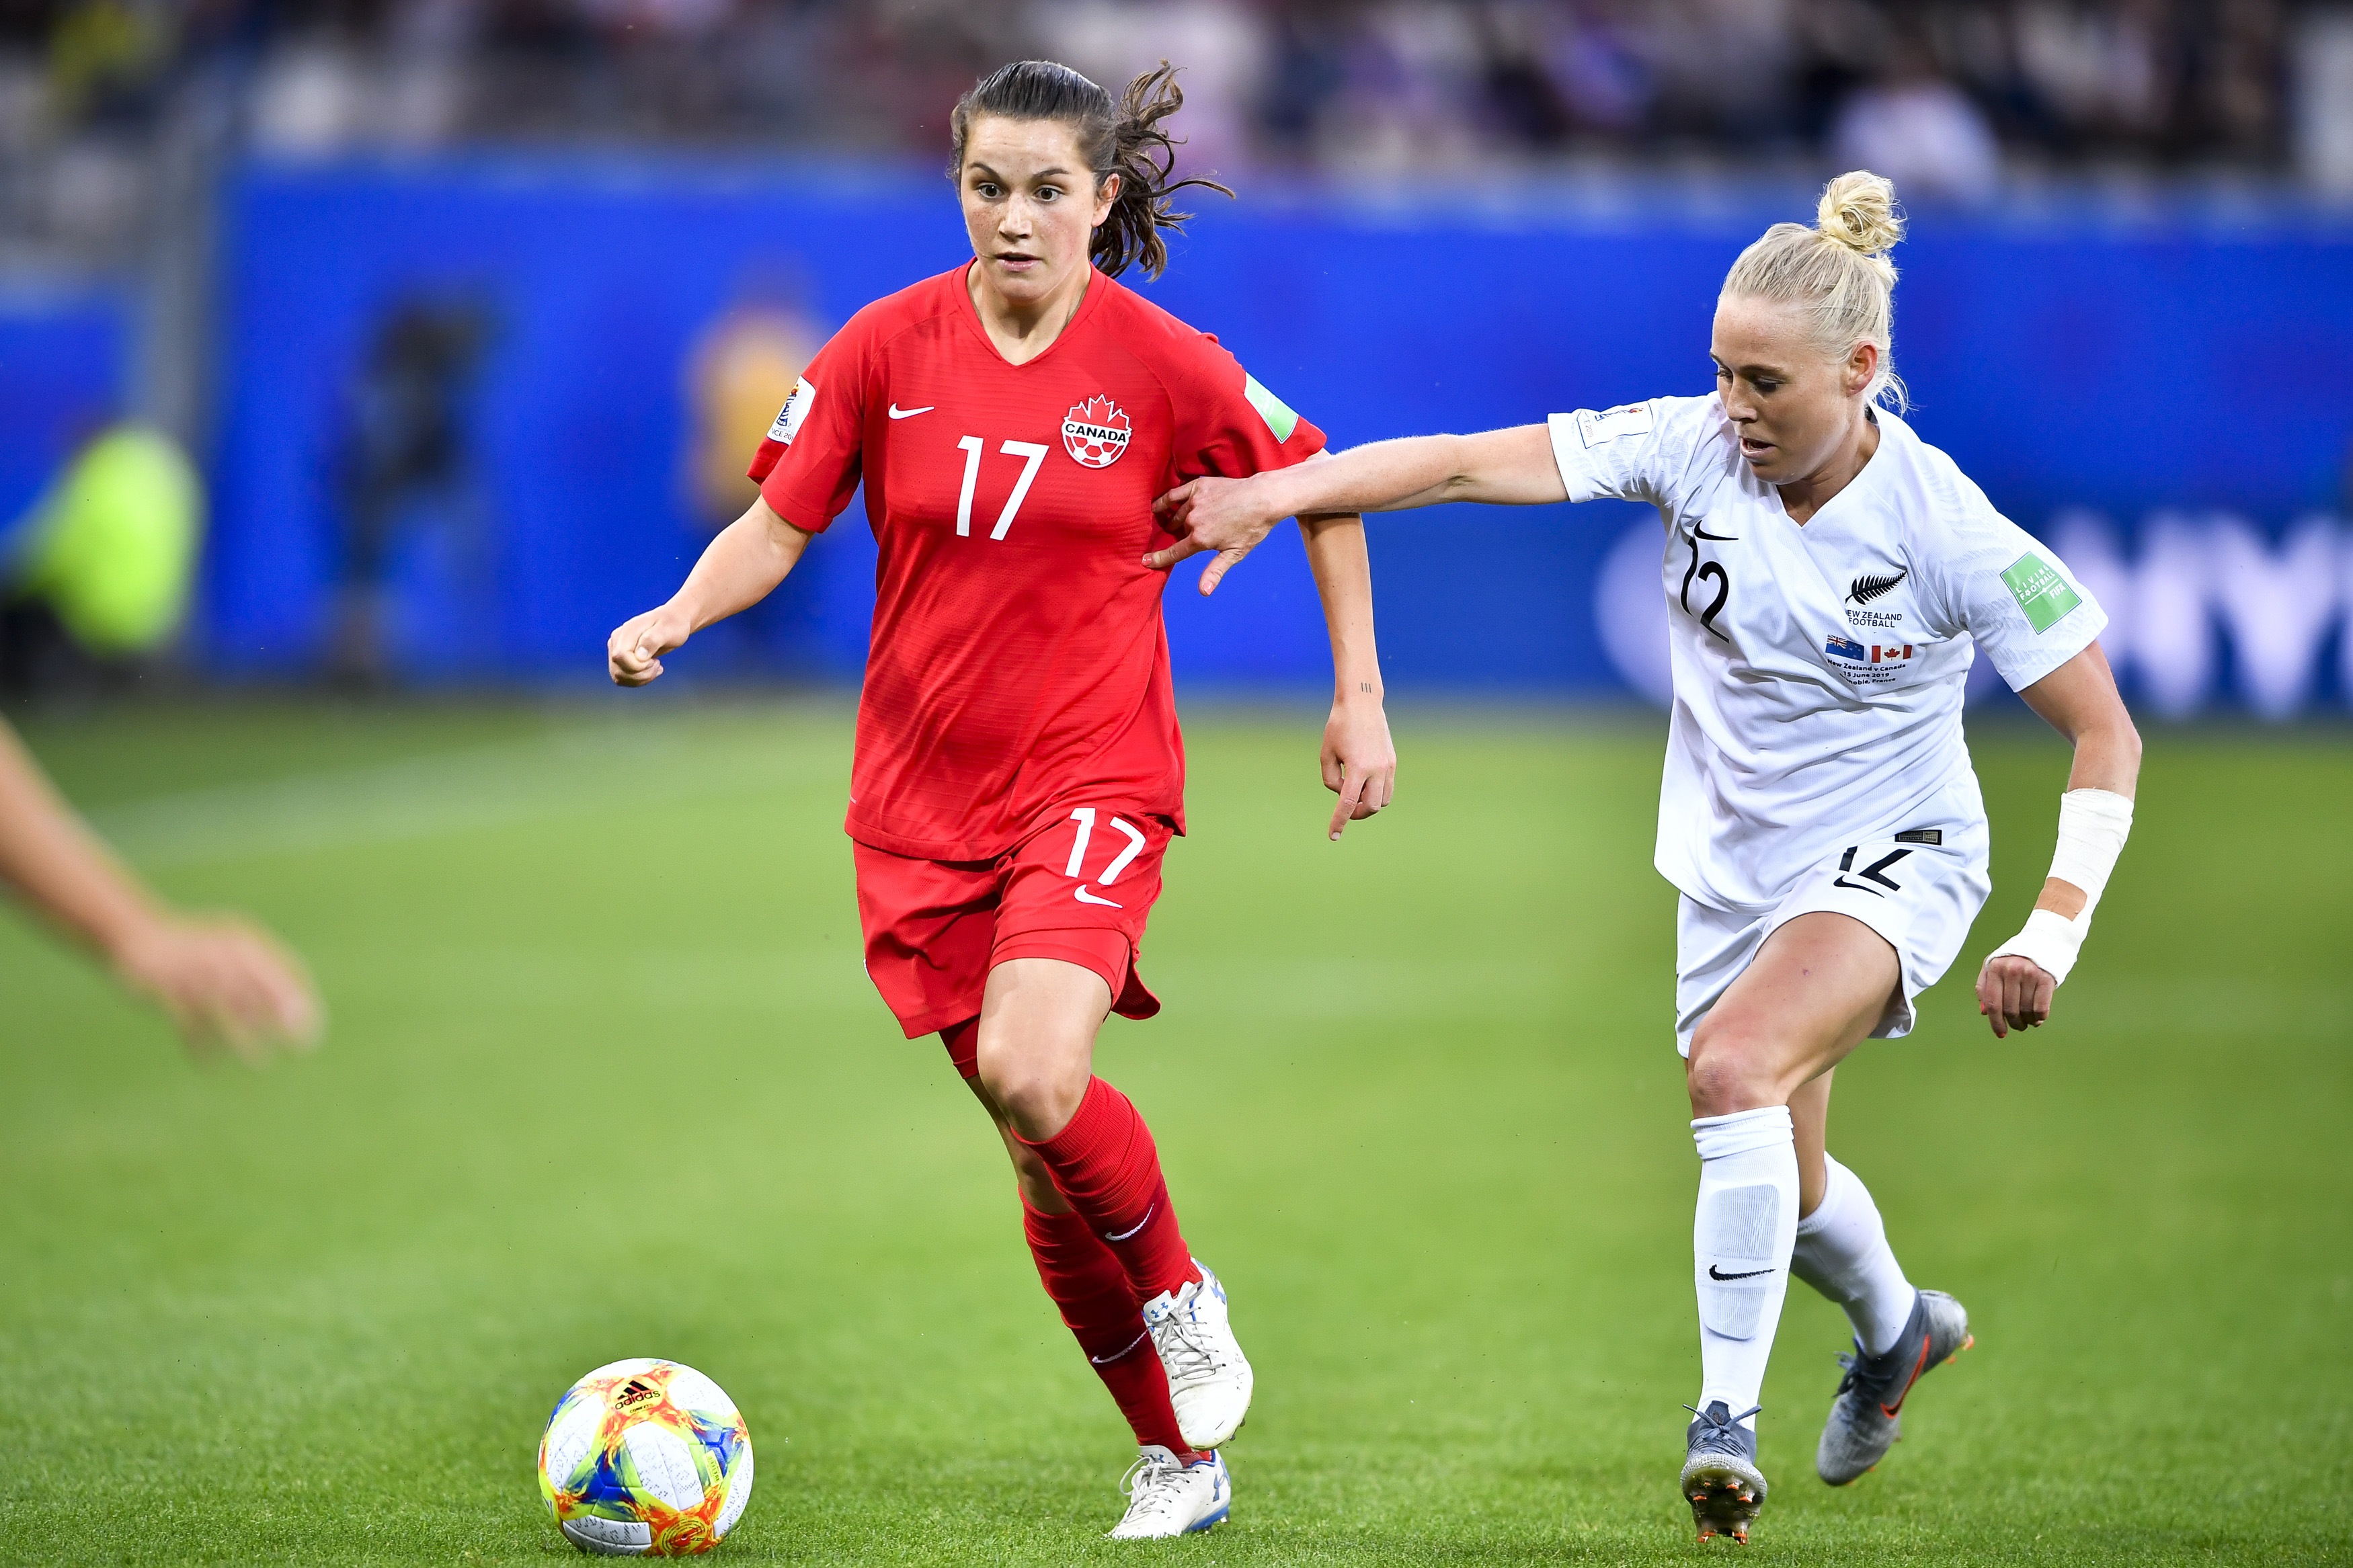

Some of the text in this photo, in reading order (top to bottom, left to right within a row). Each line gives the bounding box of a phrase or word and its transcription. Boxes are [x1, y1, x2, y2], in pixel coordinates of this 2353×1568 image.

[1065, 423, 1126, 443] CANADA
[956, 435, 1049, 541] 17
[2016, 565, 2050, 594] LIVING
[2019, 571, 2056, 601] FOOTBALL
[1681, 537, 1730, 644] 12
[2049, 582, 2066, 600] FIFA
[1848, 617, 1895, 628] FOOTBALL
[1862, 611, 1903, 621] ZEALAND
[1827, 659, 1842, 667] New
[1843, 663, 1872, 671] Zealand
[1880, 663, 1906, 671] Canada
[1065, 807, 1146, 886] 17
[615, 1391, 661, 1409] adidas
